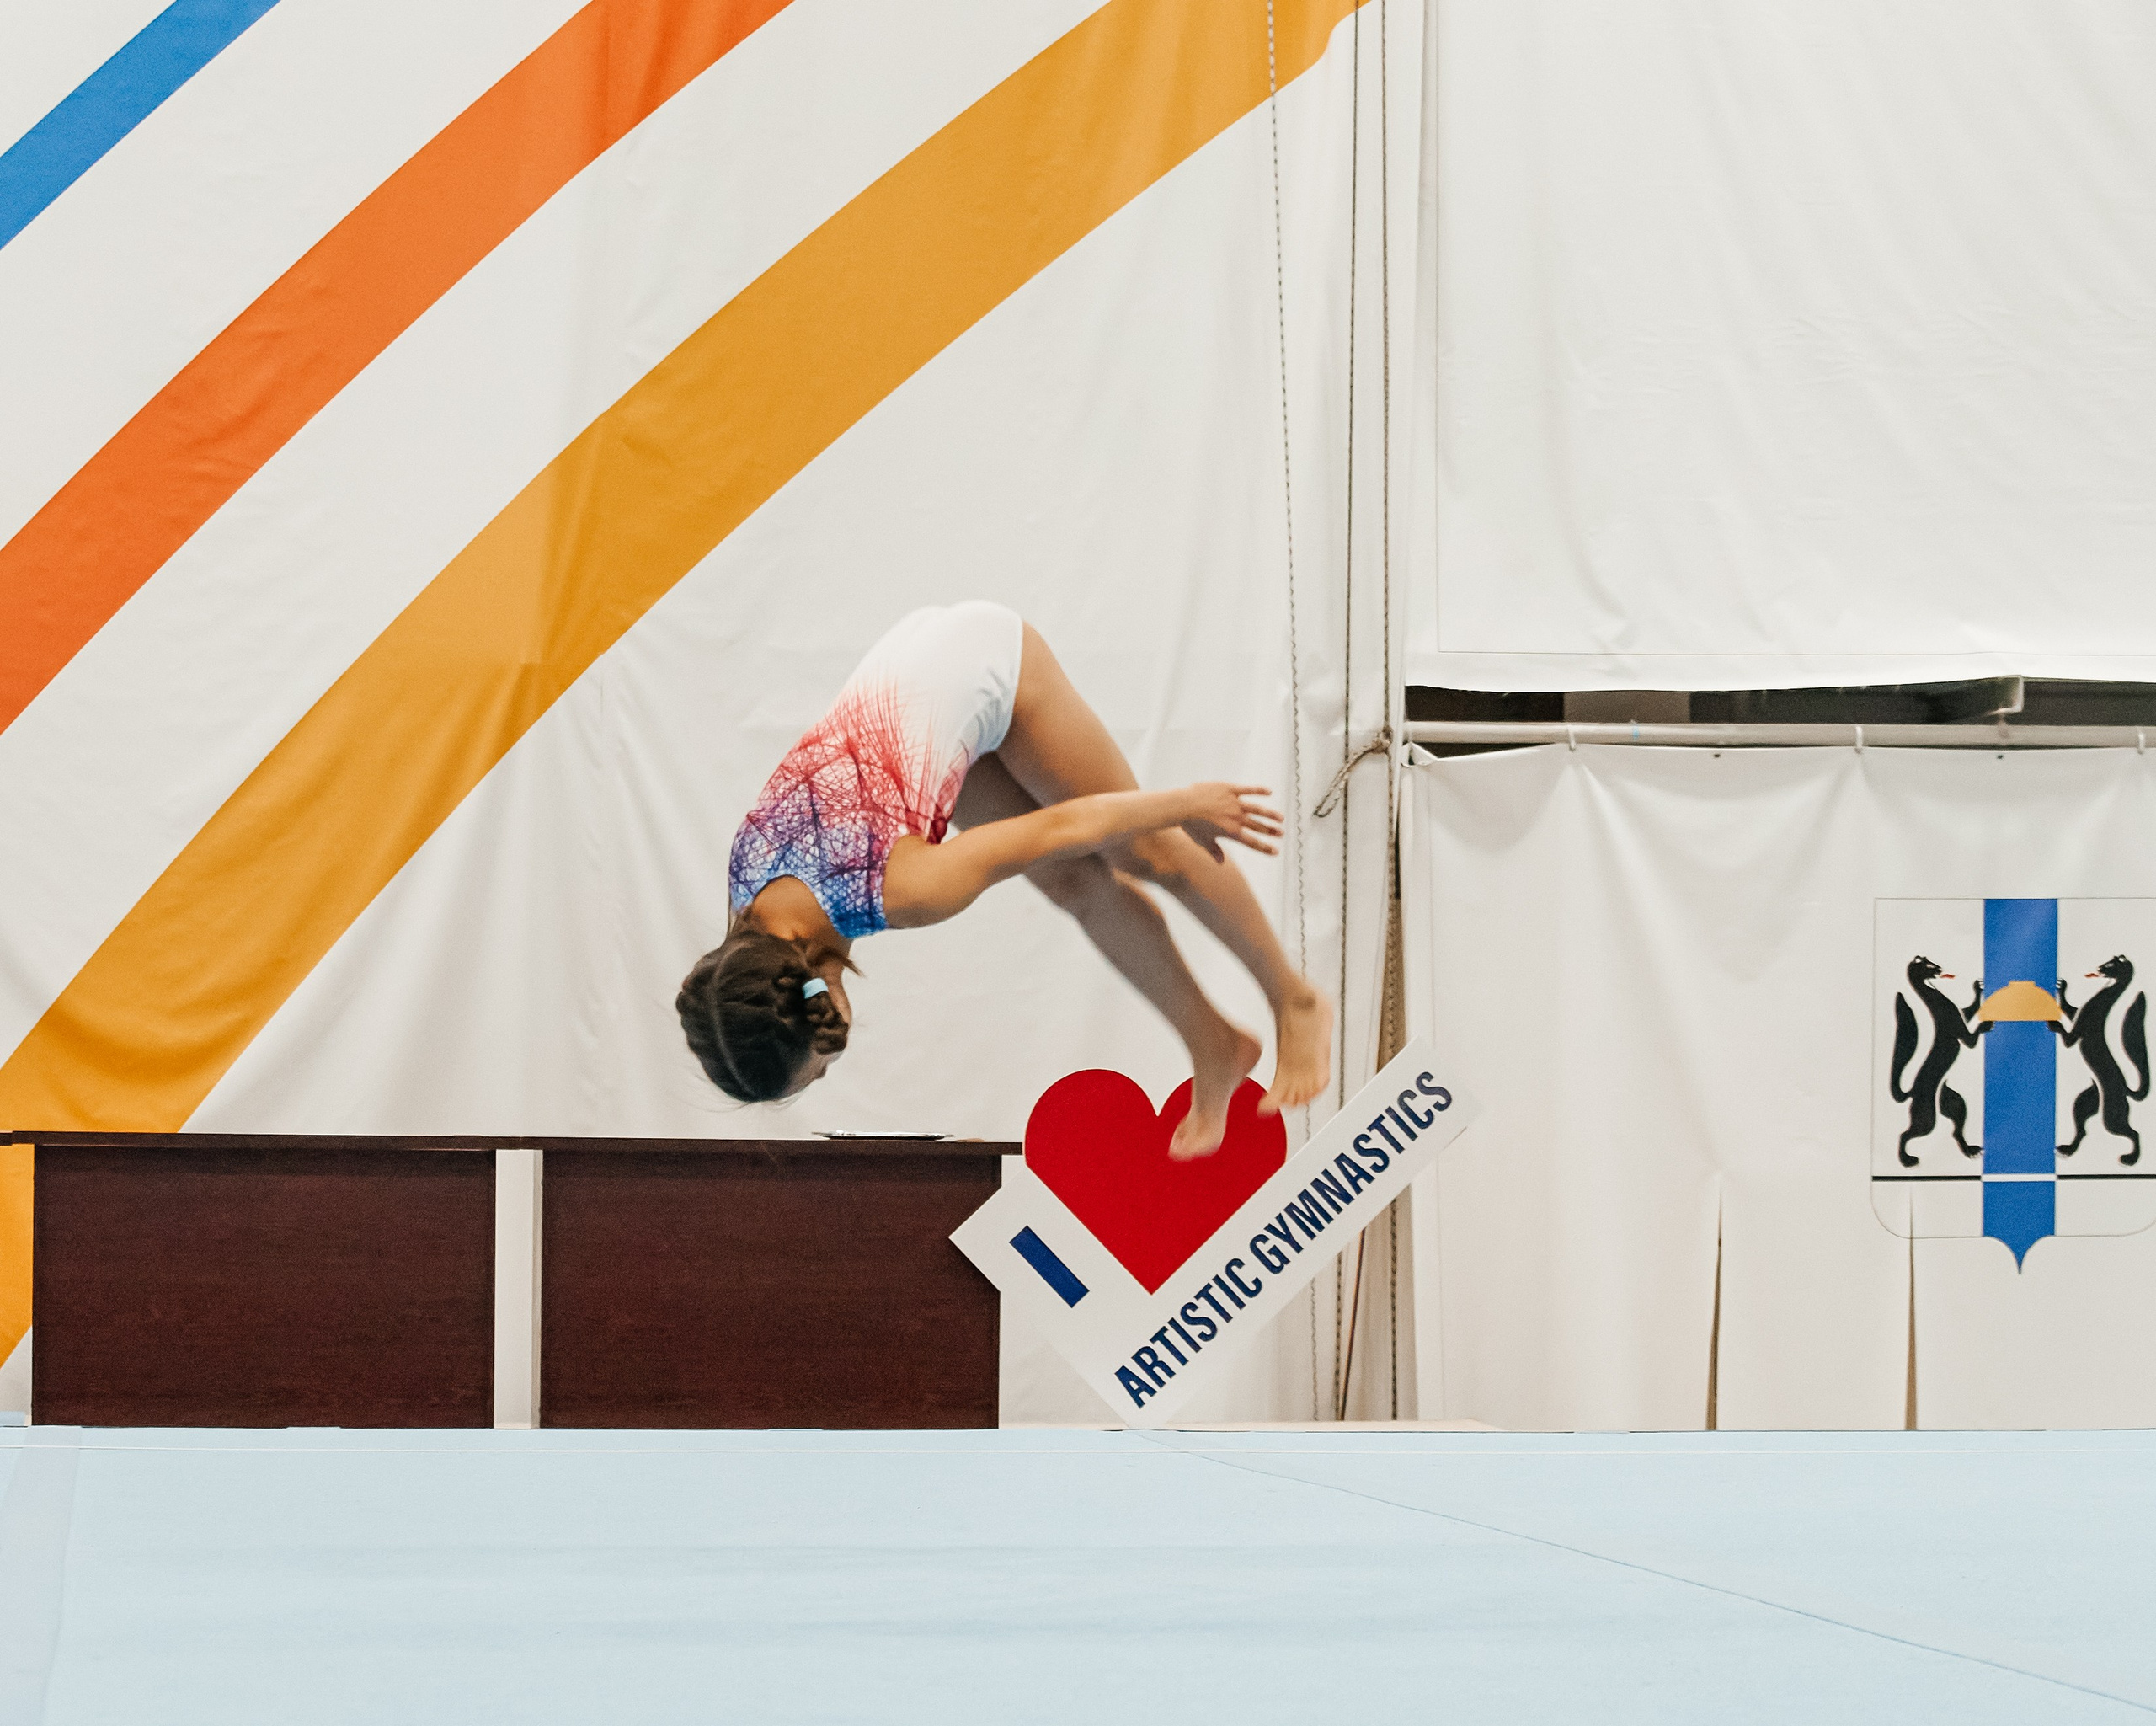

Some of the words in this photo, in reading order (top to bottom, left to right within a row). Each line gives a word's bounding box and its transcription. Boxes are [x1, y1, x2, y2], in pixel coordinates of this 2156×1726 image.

[1010, 1226, 1089, 1308] I
[1114, 1258, 1263, 1409] ARTISTIC
[1249, 1071, 1453, 1274] GYMNASTICS
